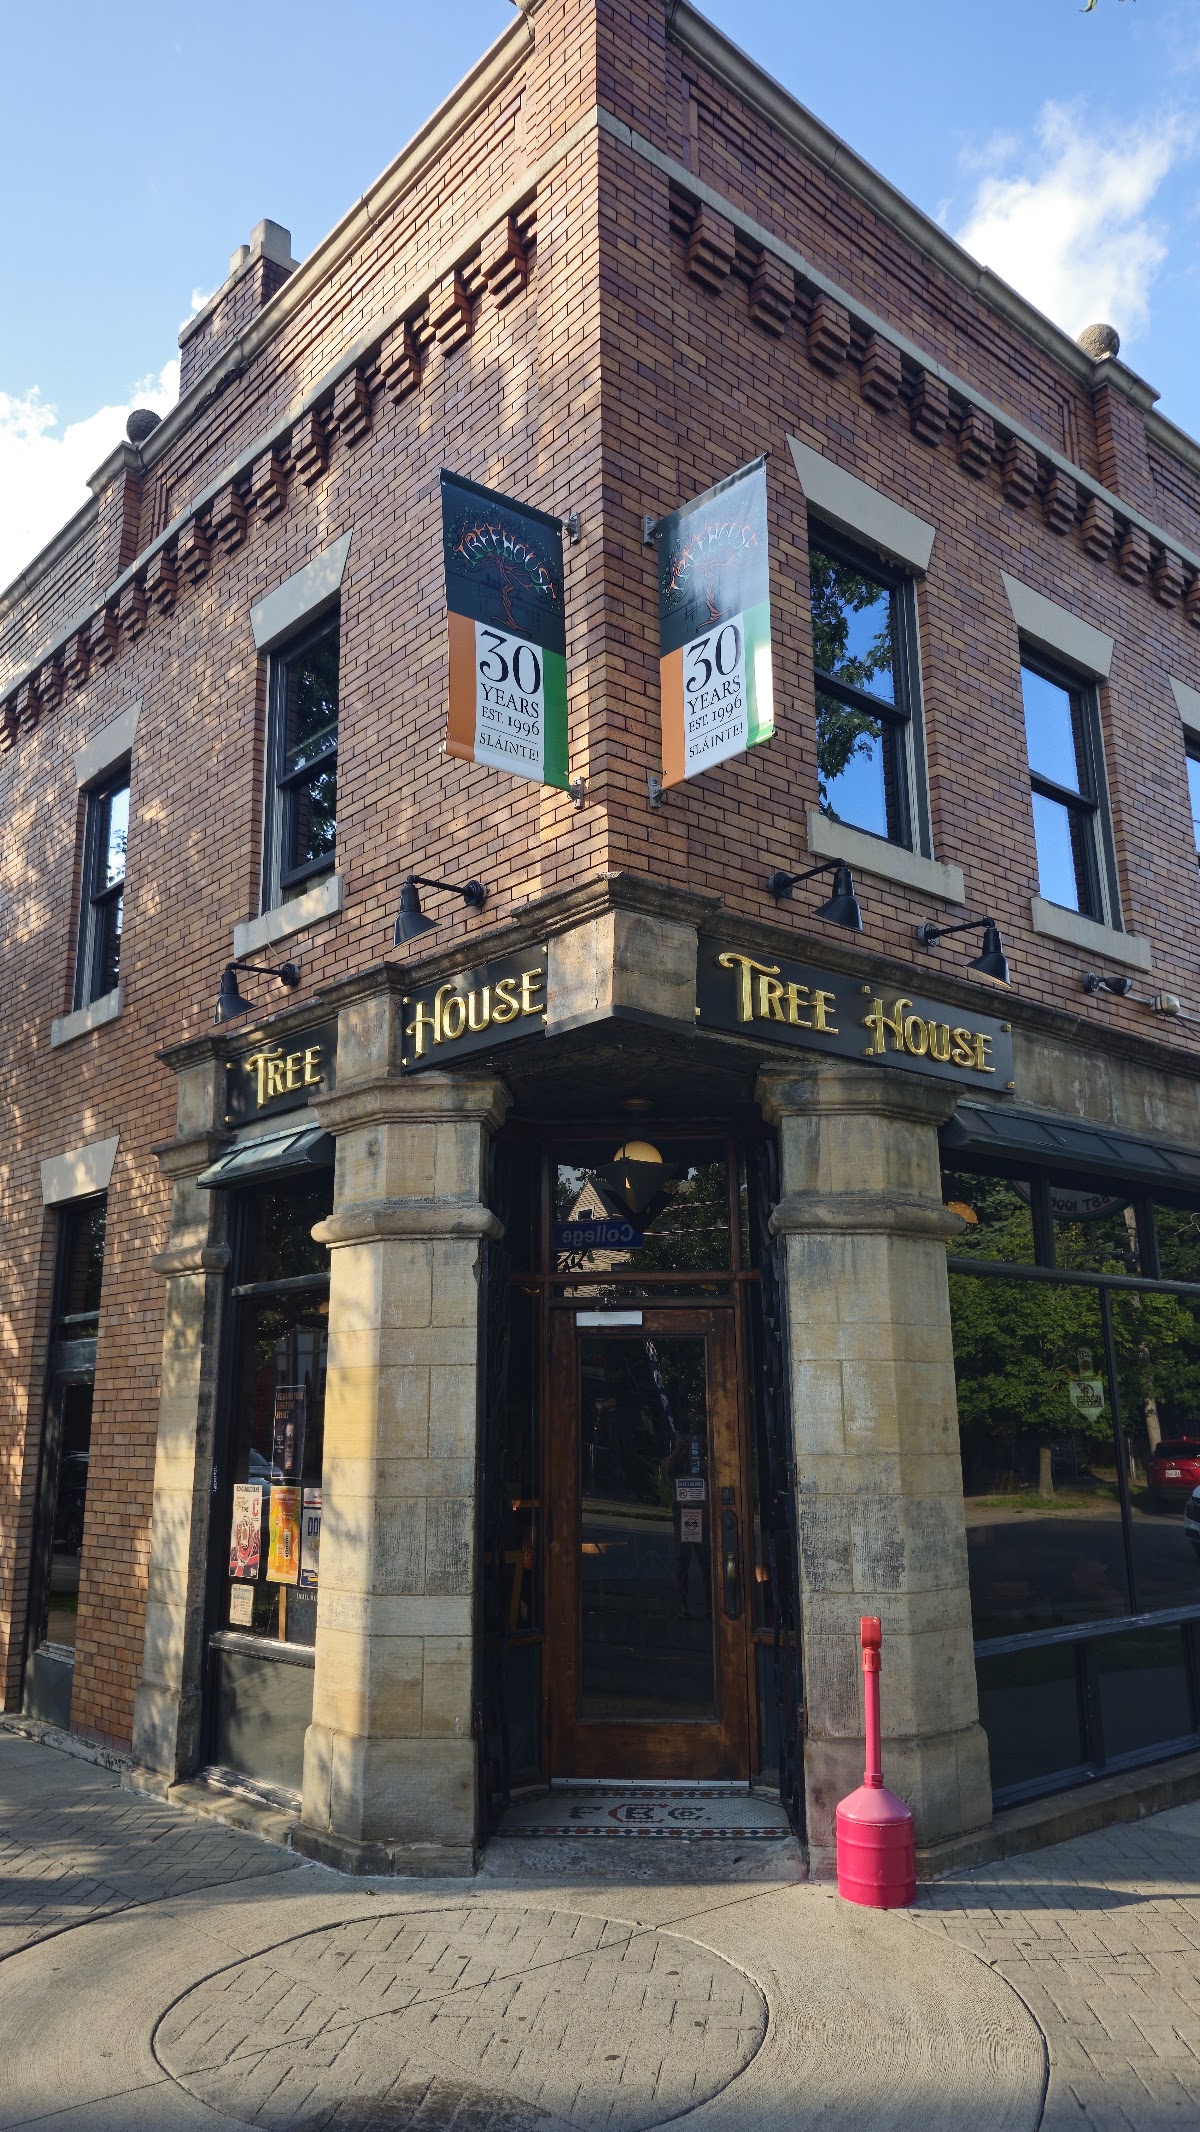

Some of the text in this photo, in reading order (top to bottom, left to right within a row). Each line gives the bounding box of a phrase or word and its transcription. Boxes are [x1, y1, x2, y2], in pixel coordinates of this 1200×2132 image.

[479, 629, 541, 695] 30
[686, 624, 742, 693] 30
[480, 682, 539, 719] YEARS
[687, 674, 741, 716] YEARS
[688, 691, 742, 733] EST. 1996
[482, 705, 540, 736] EST. 1996
[689, 721, 743, 758] SLÁINTE!
[479, 732, 539, 761] SLÁINTE!
[717, 951, 996, 1073] TREE HOUSE
[244, 967, 544, 1109] TREE HOUSE
